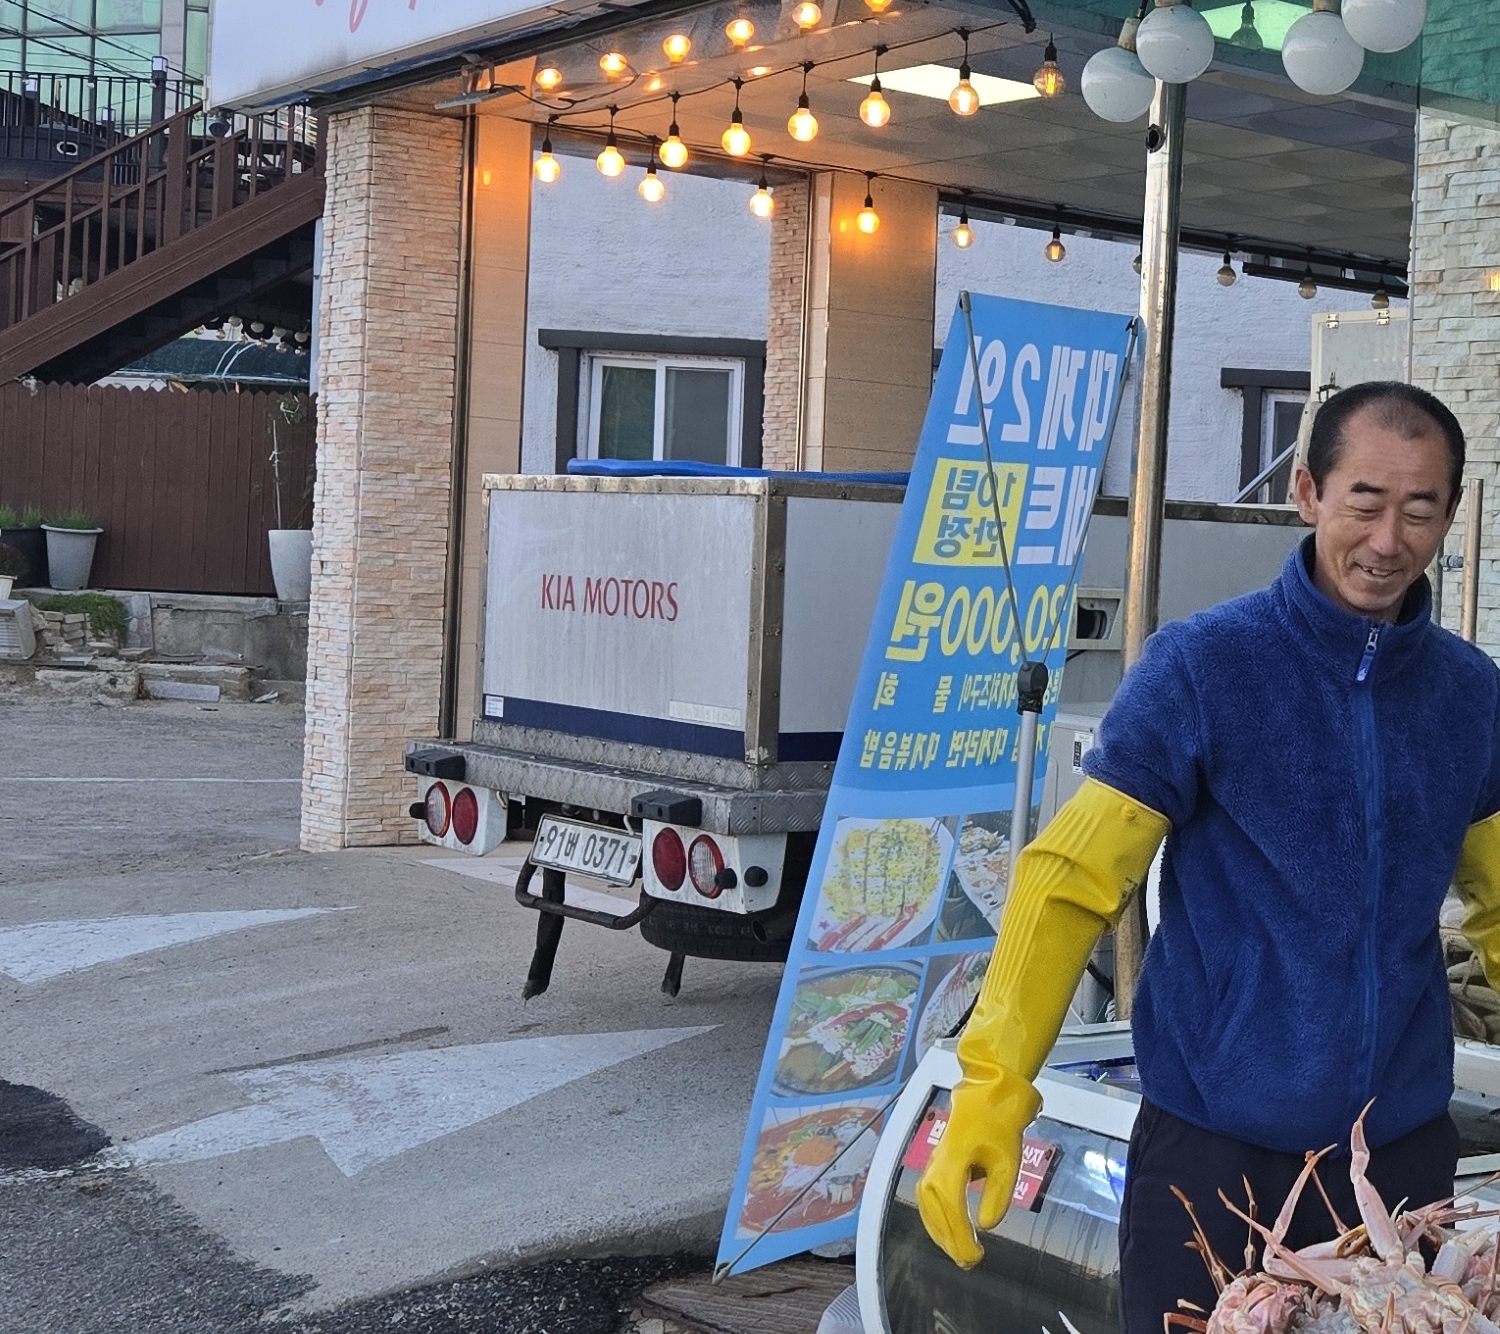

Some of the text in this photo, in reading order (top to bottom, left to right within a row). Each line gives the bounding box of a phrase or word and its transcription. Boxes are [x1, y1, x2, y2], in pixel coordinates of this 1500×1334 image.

[540, 574, 678, 621] KIA MOTORS
[583, 833, 630, 873] 0371
